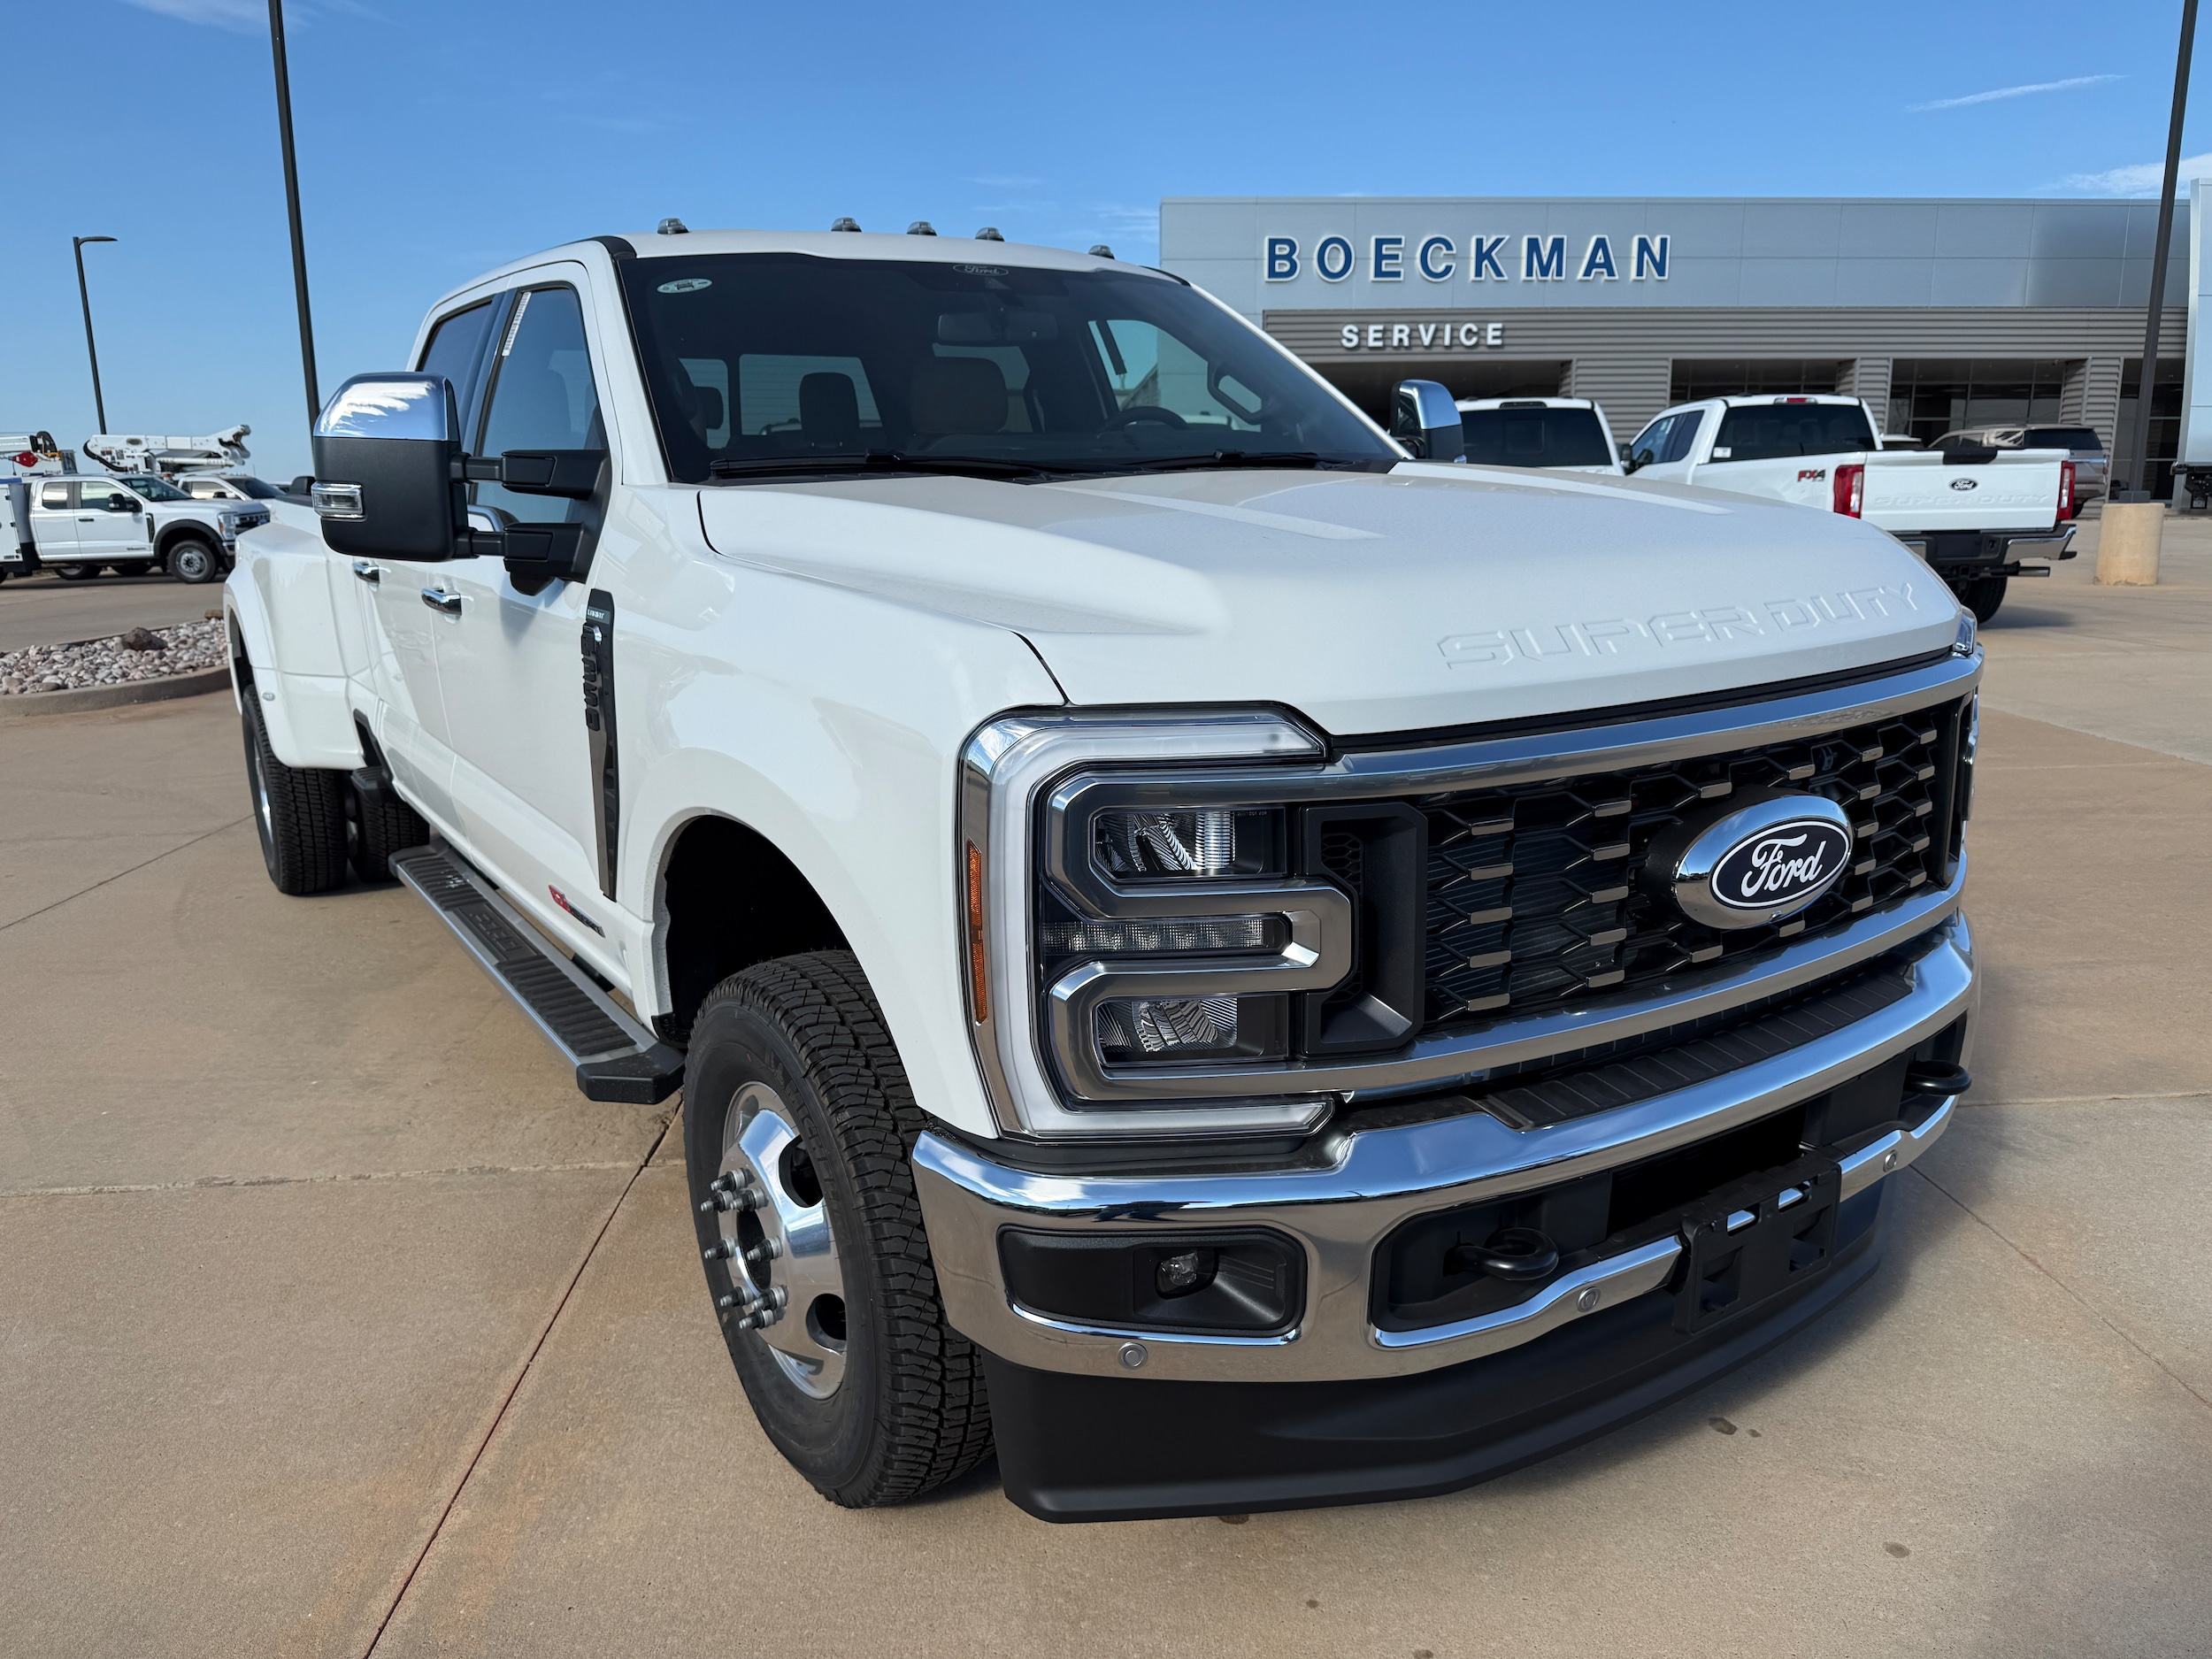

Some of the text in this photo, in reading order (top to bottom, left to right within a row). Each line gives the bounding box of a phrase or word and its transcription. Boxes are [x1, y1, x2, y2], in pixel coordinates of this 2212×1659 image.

[964, 265, 1000, 274] Ford
[1264, 234, 1671, 282] BOECKMAN
[1340, 323, 1503, 348] SERVICE
[1797, 469, 1826, 482] FX4
[1978, 495, 2048, 504] DUTY
[1437, 582, 1918, 670] SUPER DUTY
[1740, 833, 1827, 897] Ford
